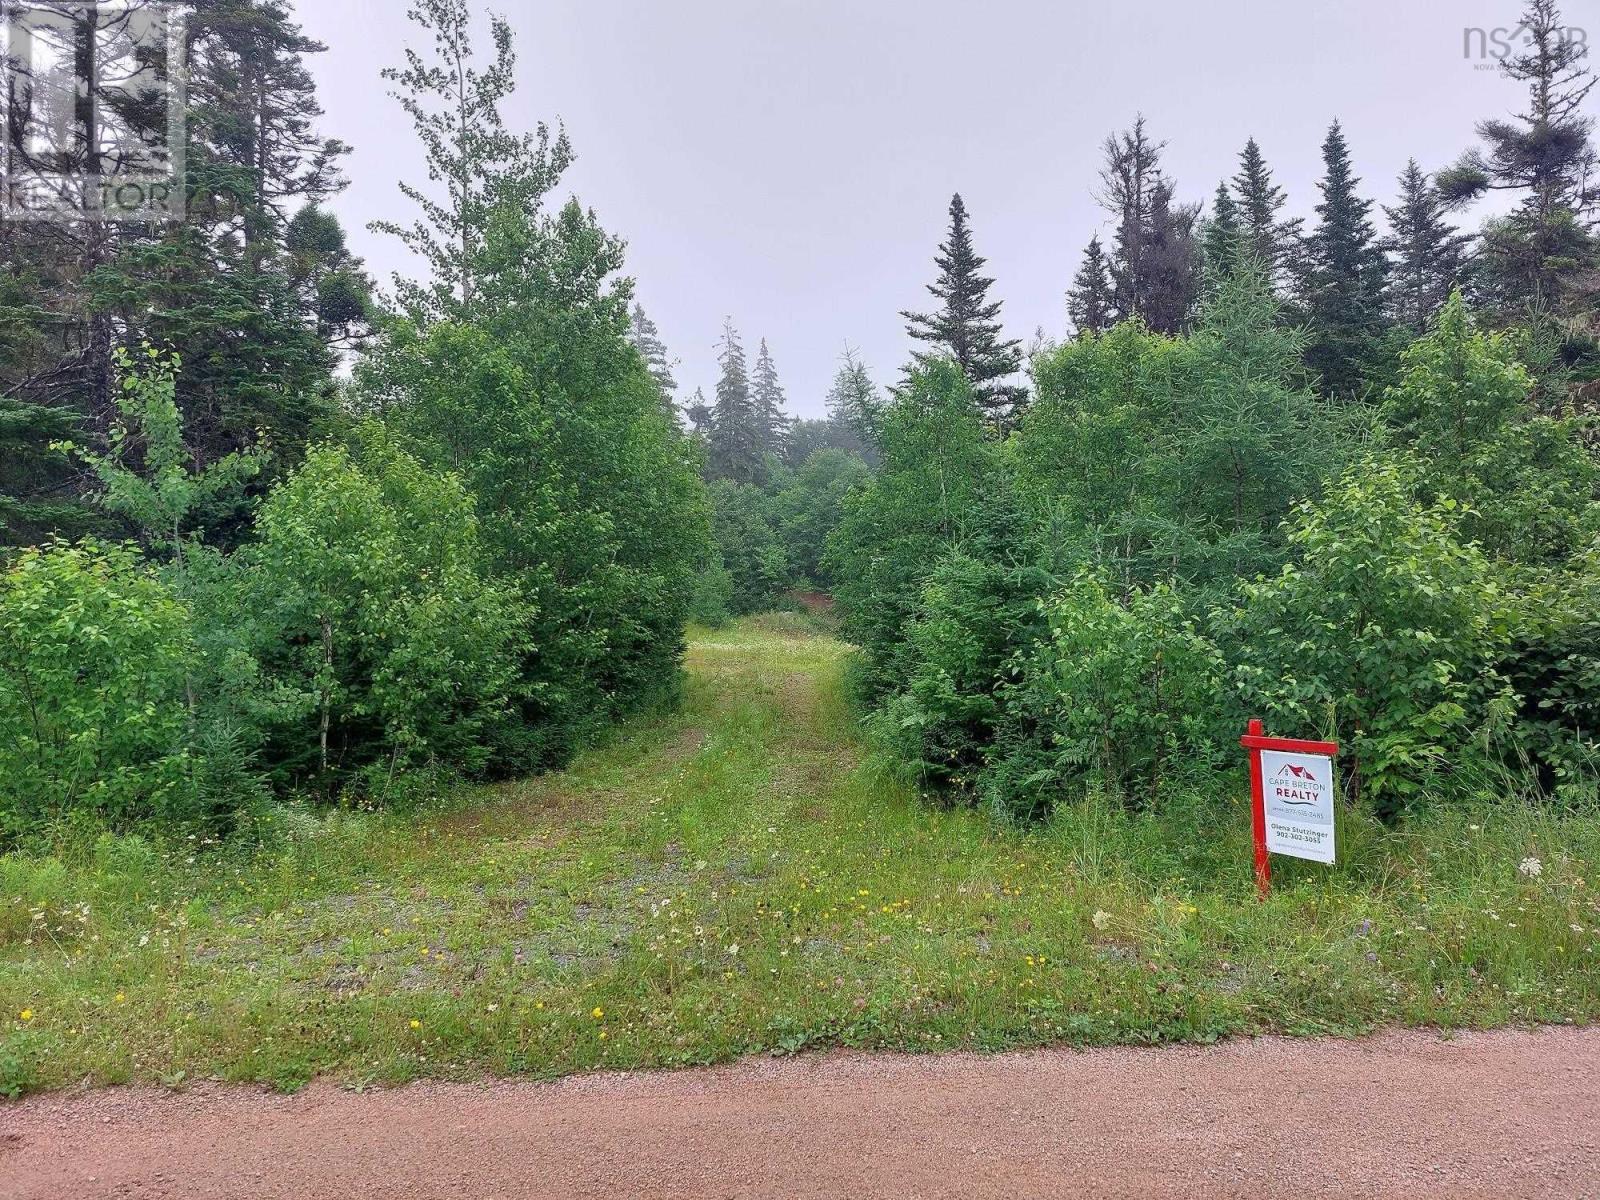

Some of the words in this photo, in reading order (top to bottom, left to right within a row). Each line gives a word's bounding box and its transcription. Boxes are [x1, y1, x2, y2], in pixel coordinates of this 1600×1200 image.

[1269, 778, 1289, 786] CAPE
[1292, 781, 1325, 791] BRETON
[1277, 788, 1318, 801] REALTY
[1292, 827, 1328, 838] Stutzinger
